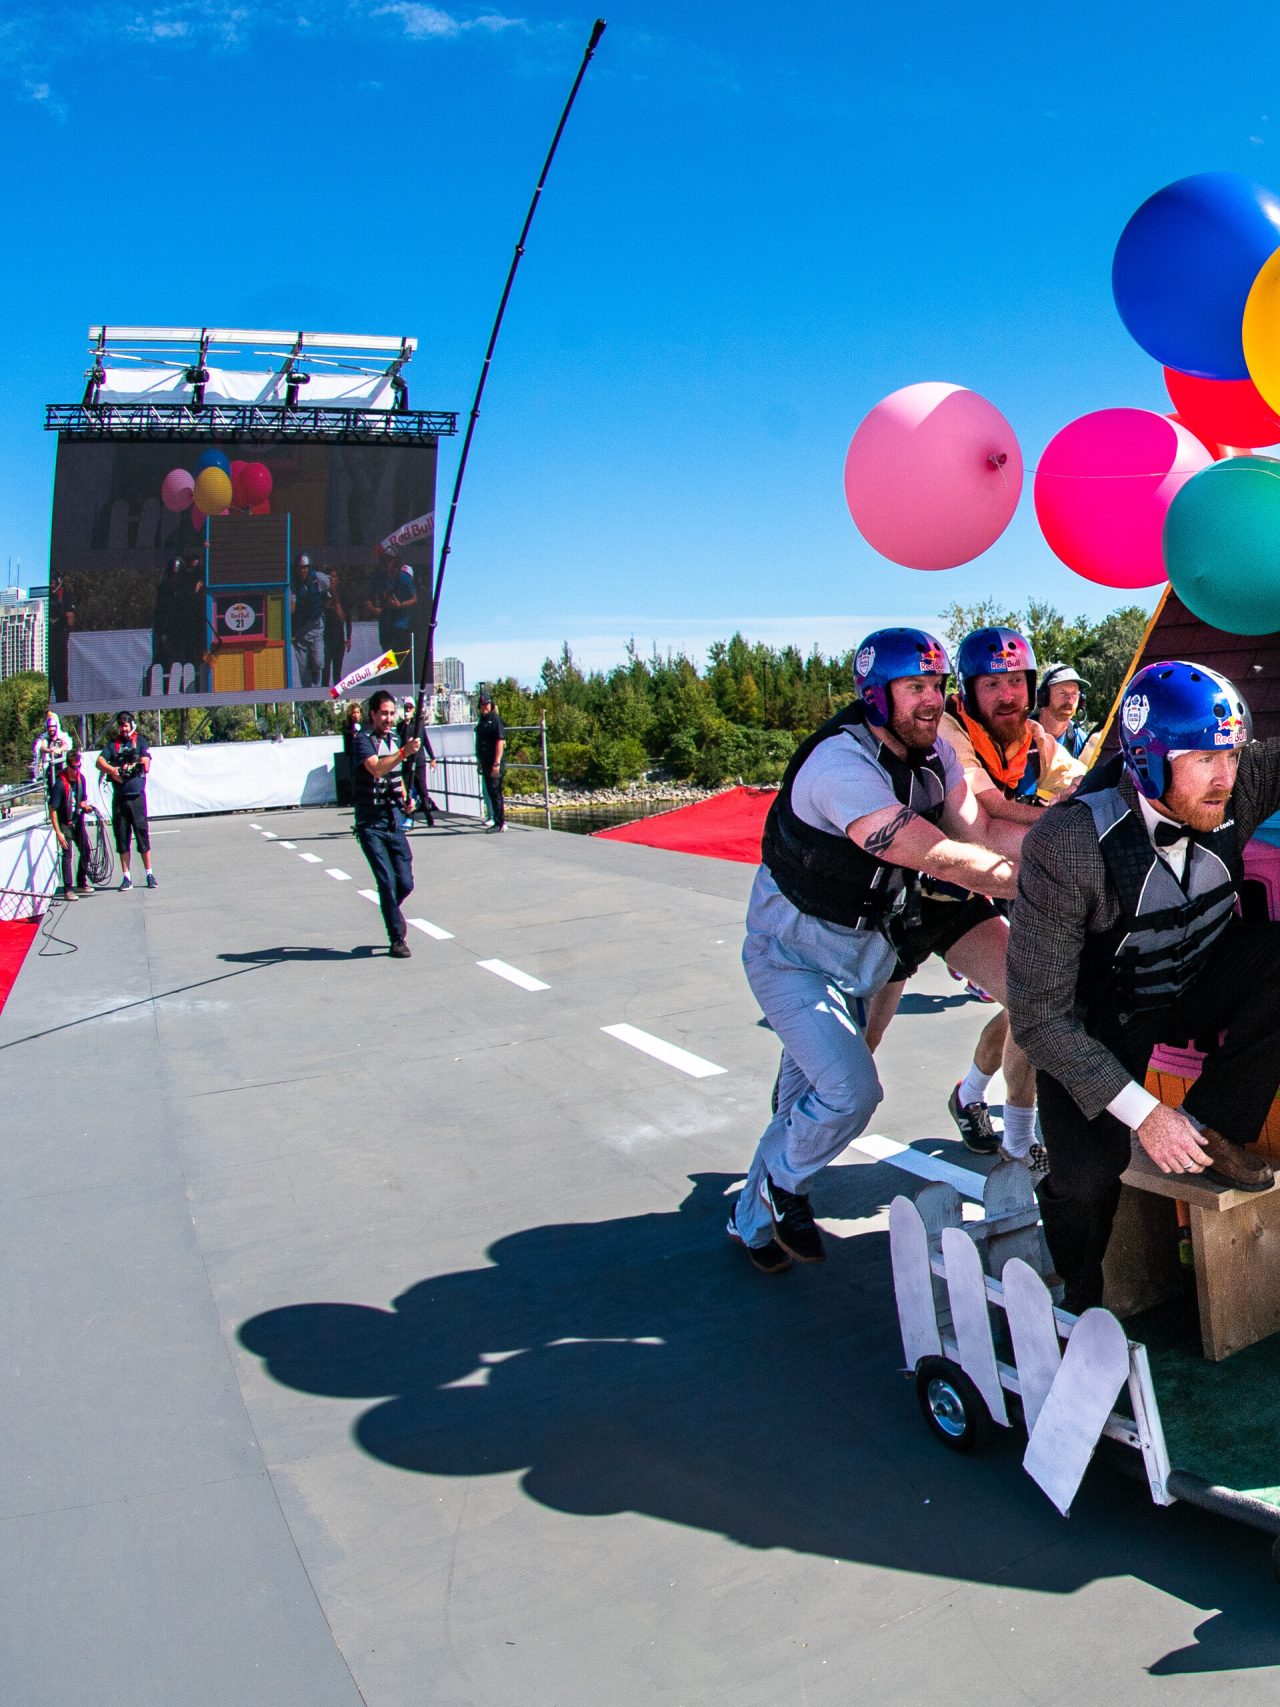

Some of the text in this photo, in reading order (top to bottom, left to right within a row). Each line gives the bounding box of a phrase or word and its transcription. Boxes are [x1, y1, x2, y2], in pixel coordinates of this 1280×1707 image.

[390, 526, 412, 545] Red
[235, 619, 245, 628] 21
[991, 658, 1021, 670] Red Bull
[340, 667, 372, 690] Red Bull
[1215, 732, 1234, 745] Red
